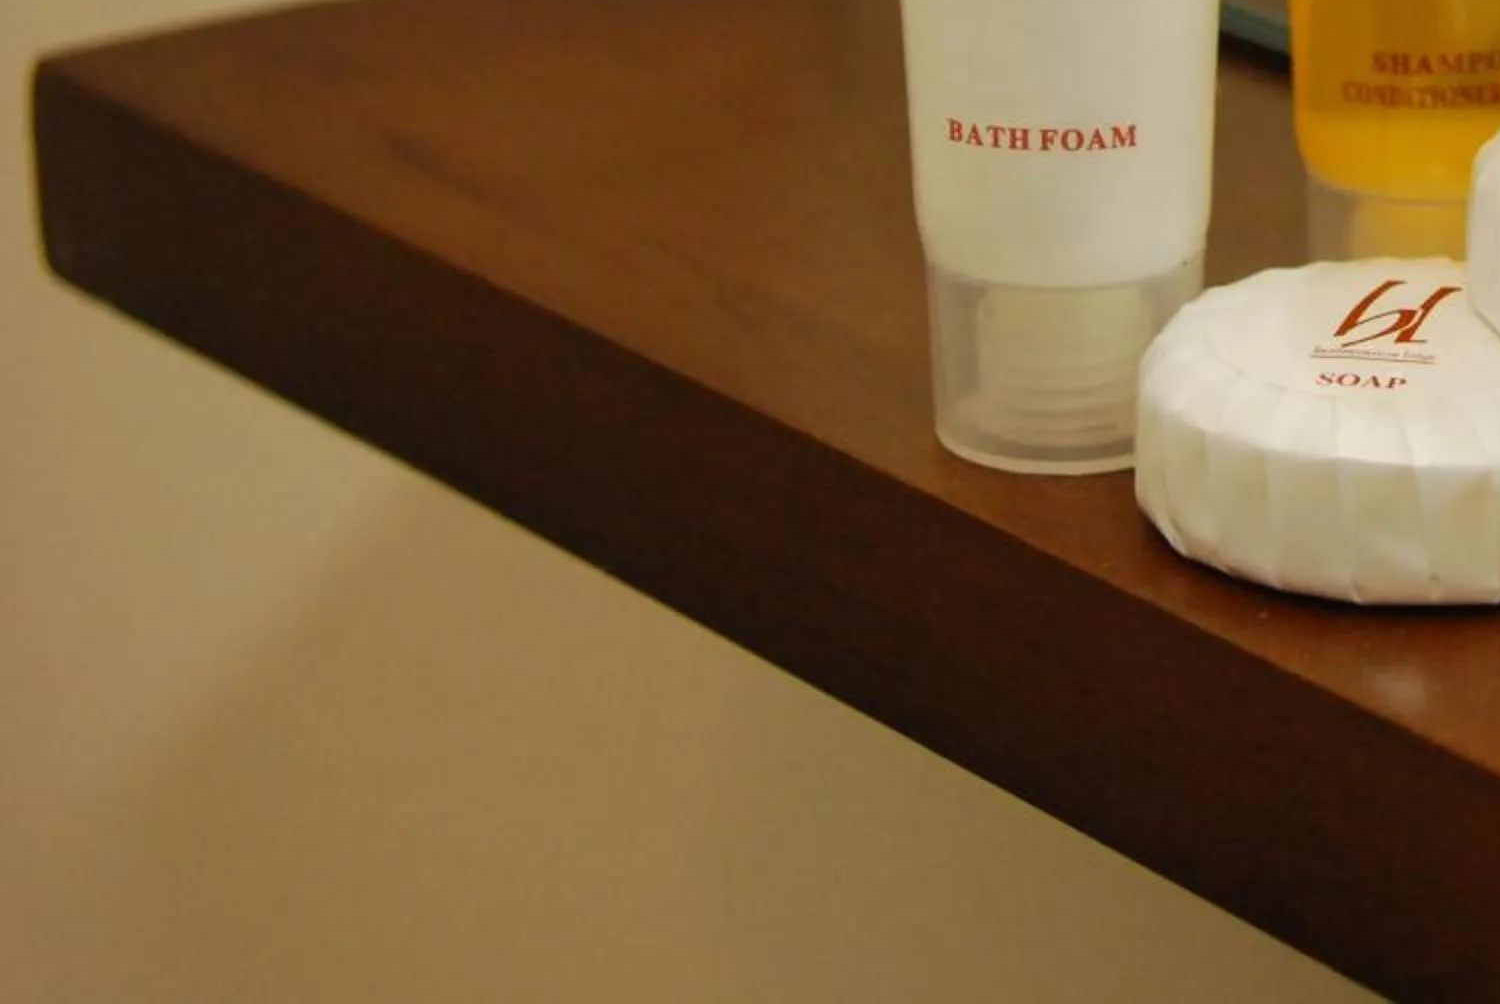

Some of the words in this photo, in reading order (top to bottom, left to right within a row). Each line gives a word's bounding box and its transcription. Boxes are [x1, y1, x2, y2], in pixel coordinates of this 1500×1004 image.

[946, 117, 1031, 150] BATH
[1039, 124, 1137, 151] FOAM
[1316, 371, 1407, 389] SOAP
